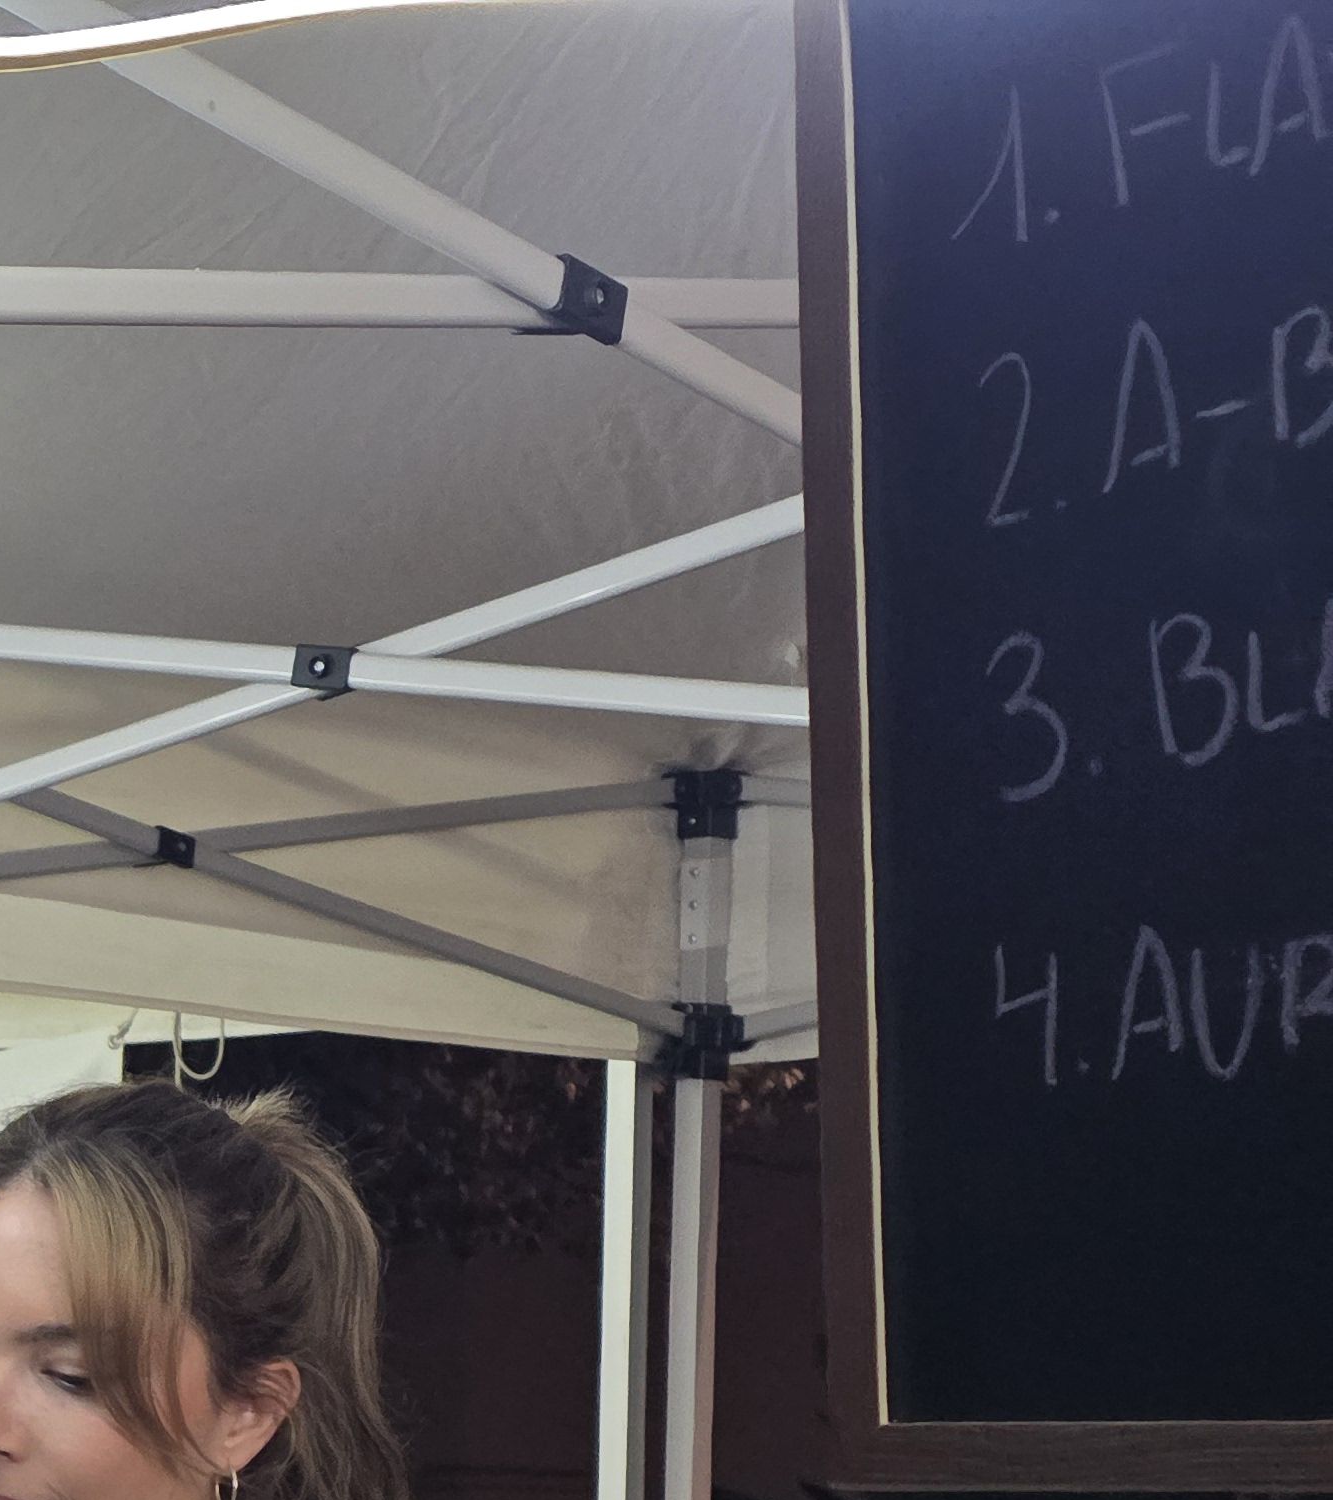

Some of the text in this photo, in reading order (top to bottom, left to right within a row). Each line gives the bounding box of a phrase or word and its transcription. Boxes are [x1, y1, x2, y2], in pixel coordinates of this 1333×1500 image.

[951, 15, 1333, 243] 1. FLA
[978, 350, 1068, 528] 2.
[985, 595, 1333, 802] 3. BL
[994, 943, 1092, 1087] 4.
